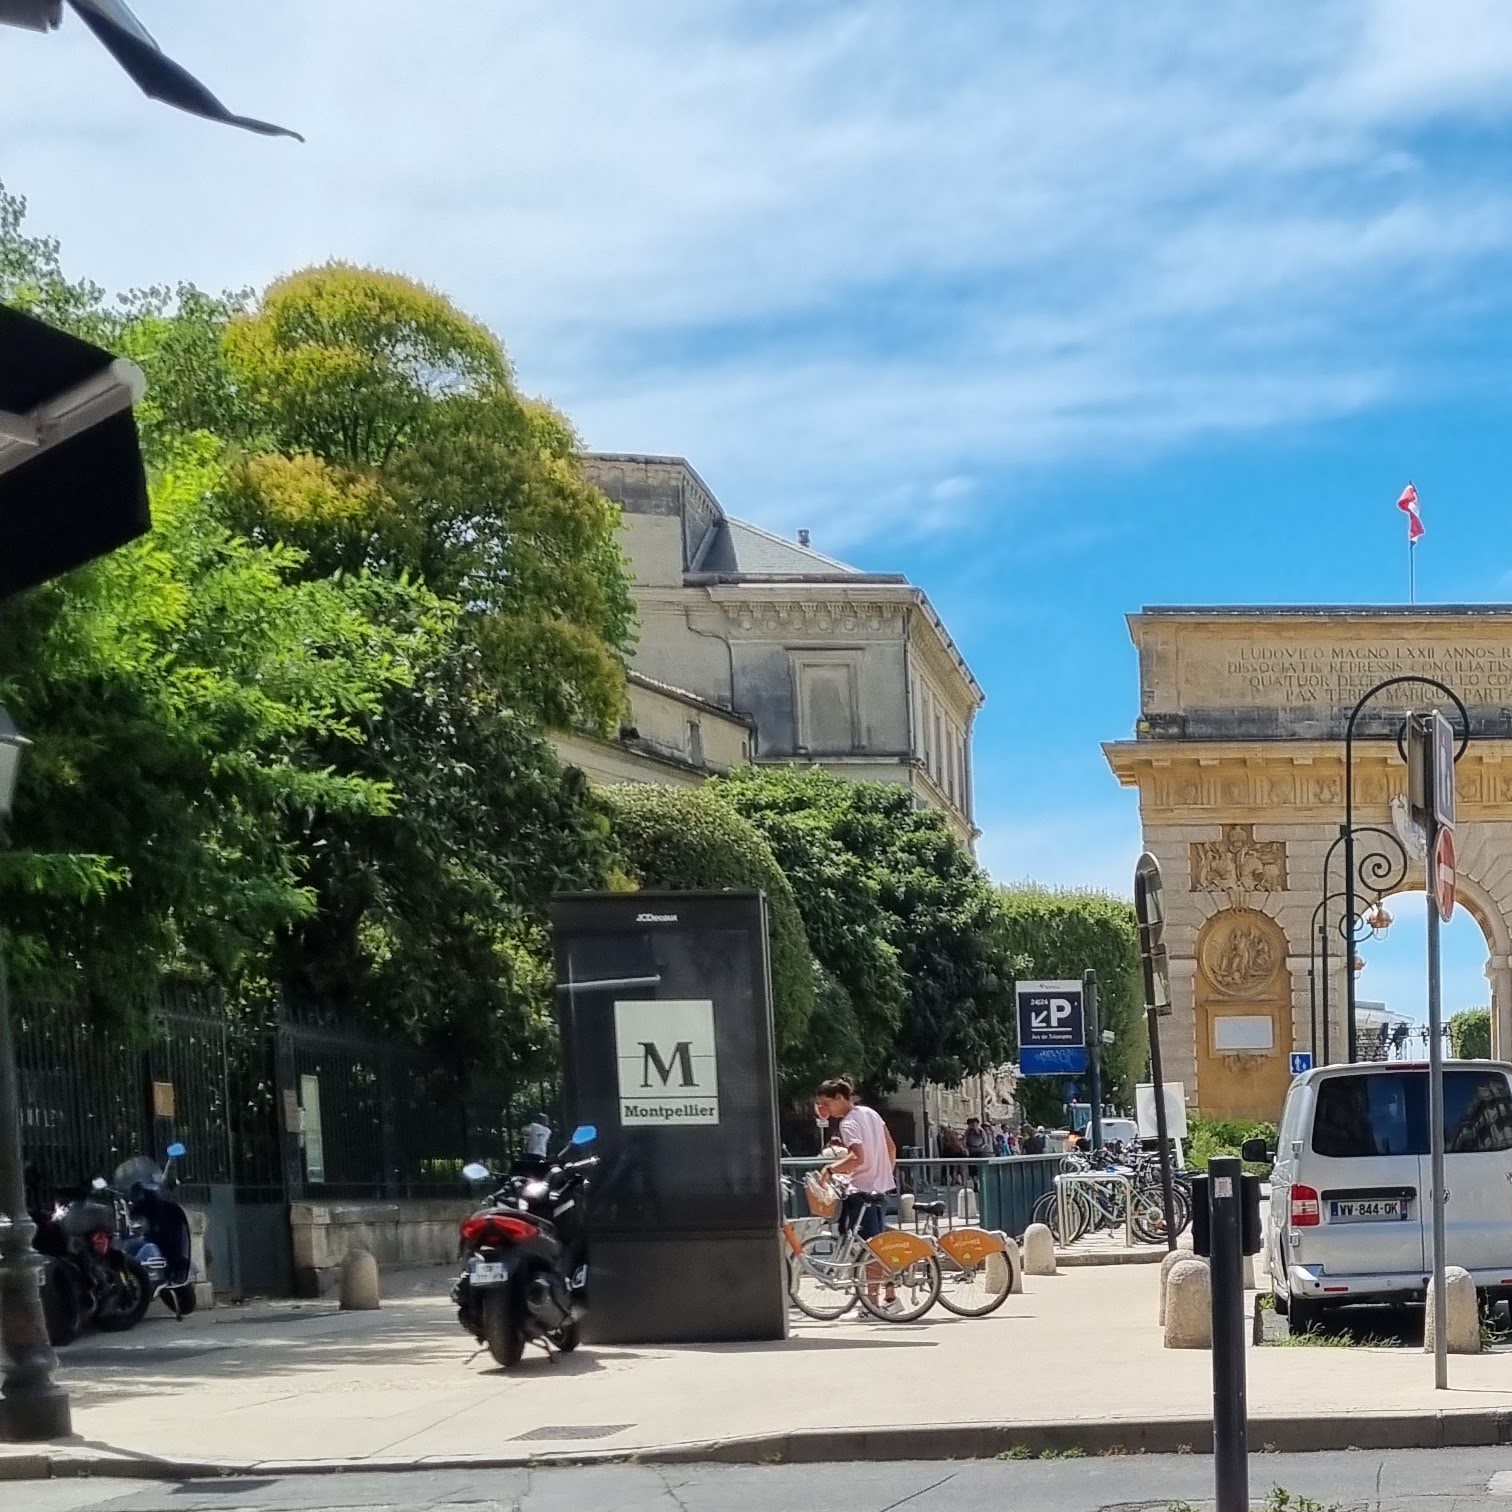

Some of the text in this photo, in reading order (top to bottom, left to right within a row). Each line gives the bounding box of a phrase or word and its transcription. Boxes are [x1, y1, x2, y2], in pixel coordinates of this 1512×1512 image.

[1240, 648, 1325, 660] LUDOVICO
[1331, 647, 1389, 659] MAGNO
[1396, 647, 1435, 659] LXXII
[1442, 647, 1495, 659] ANNOS
[1329, 660, 1403, 673] REPRESSIS
[1249, 674, 1329, 690] QUATUOR
[1285, 689, 1317, 702] PAX
[1050, 999, 1071, 1026] P
[637, 1041, 701, 1088] M
[624, 1104, 716, 1120] Montpellier
